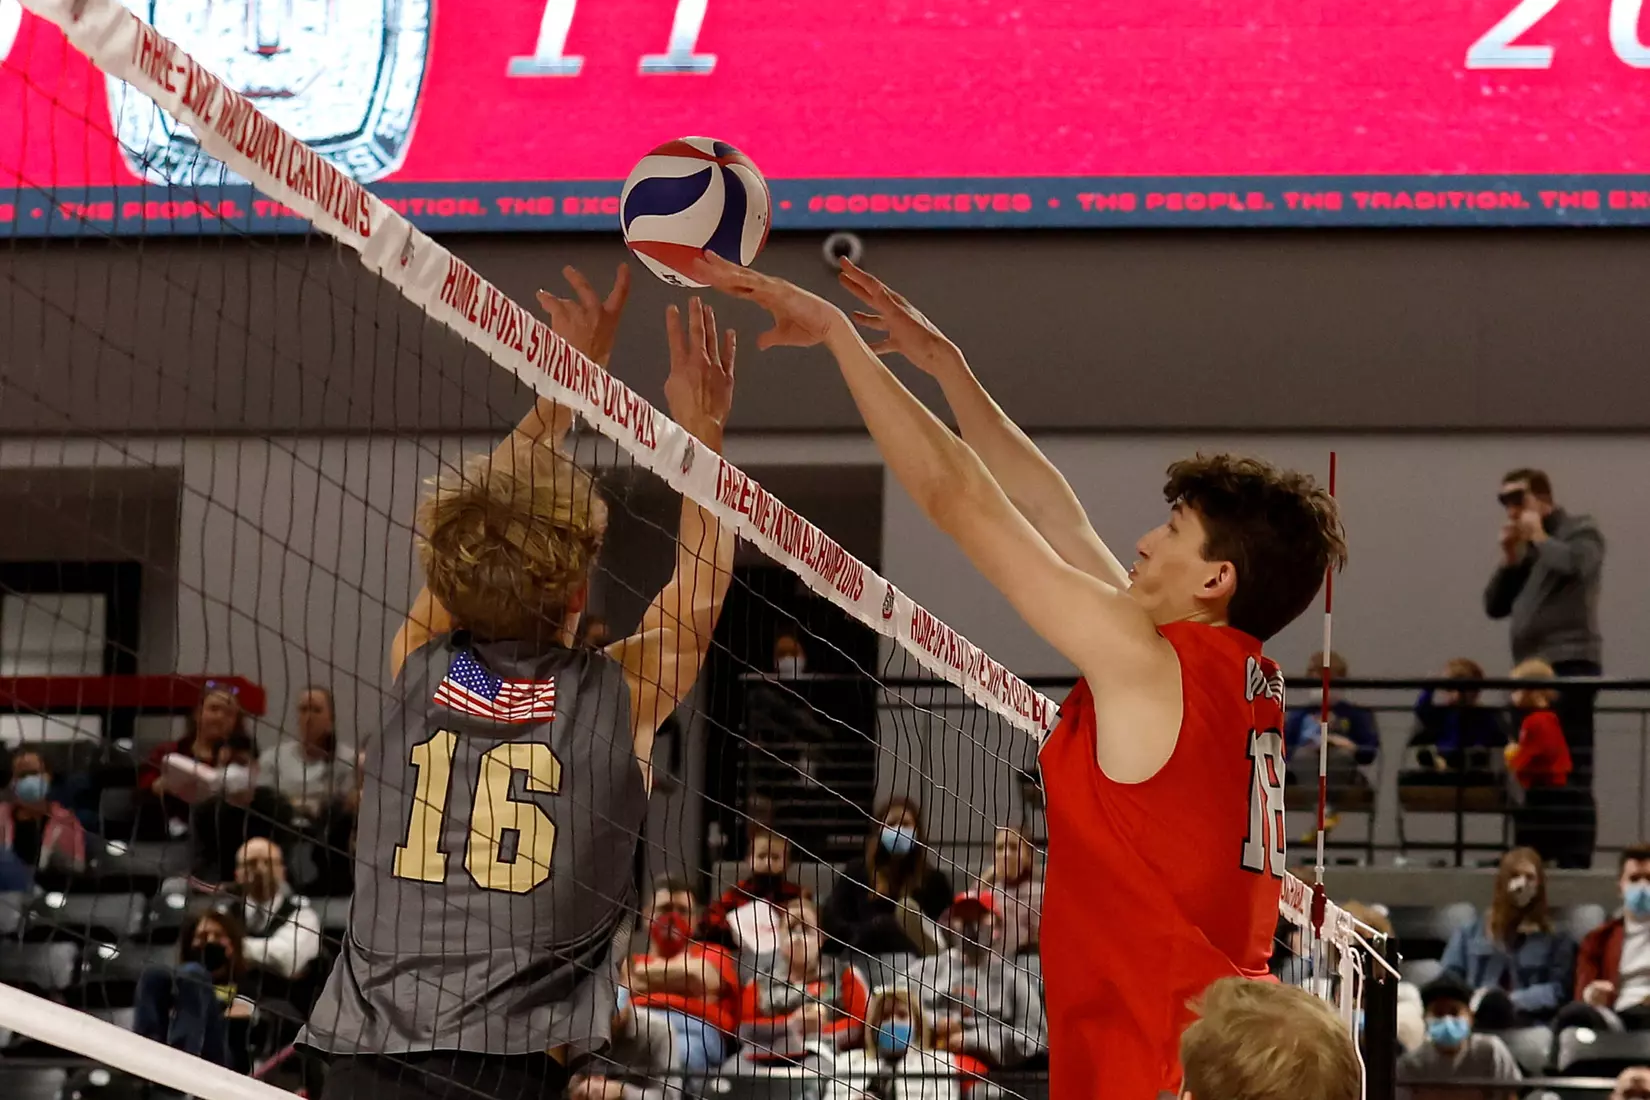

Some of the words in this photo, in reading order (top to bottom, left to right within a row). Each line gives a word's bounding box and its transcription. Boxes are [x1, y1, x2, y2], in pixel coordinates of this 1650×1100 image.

[58, 202, 113, 220] THE
[122, 200, 243, 219] PEOPLE.
[381, 197, 486, 216] ITION.
[496, 197, 553, 215] THE
[808, 193, 1032, 213] #GOBUCKEYES
[1077, 192, 1136, 211] THE
[1145, 192, 1273, 211] PEOPLE.
[1283, 191, 1342, 210] THE
[1351, 191, 1529, 210] TRADITION.
[1538, 190, 1599, 209] THE
[496, 297, 528, 352] OHI
[812, 530, 864, 601] HAMPIONS
[391, 728, 563, 895] 16
